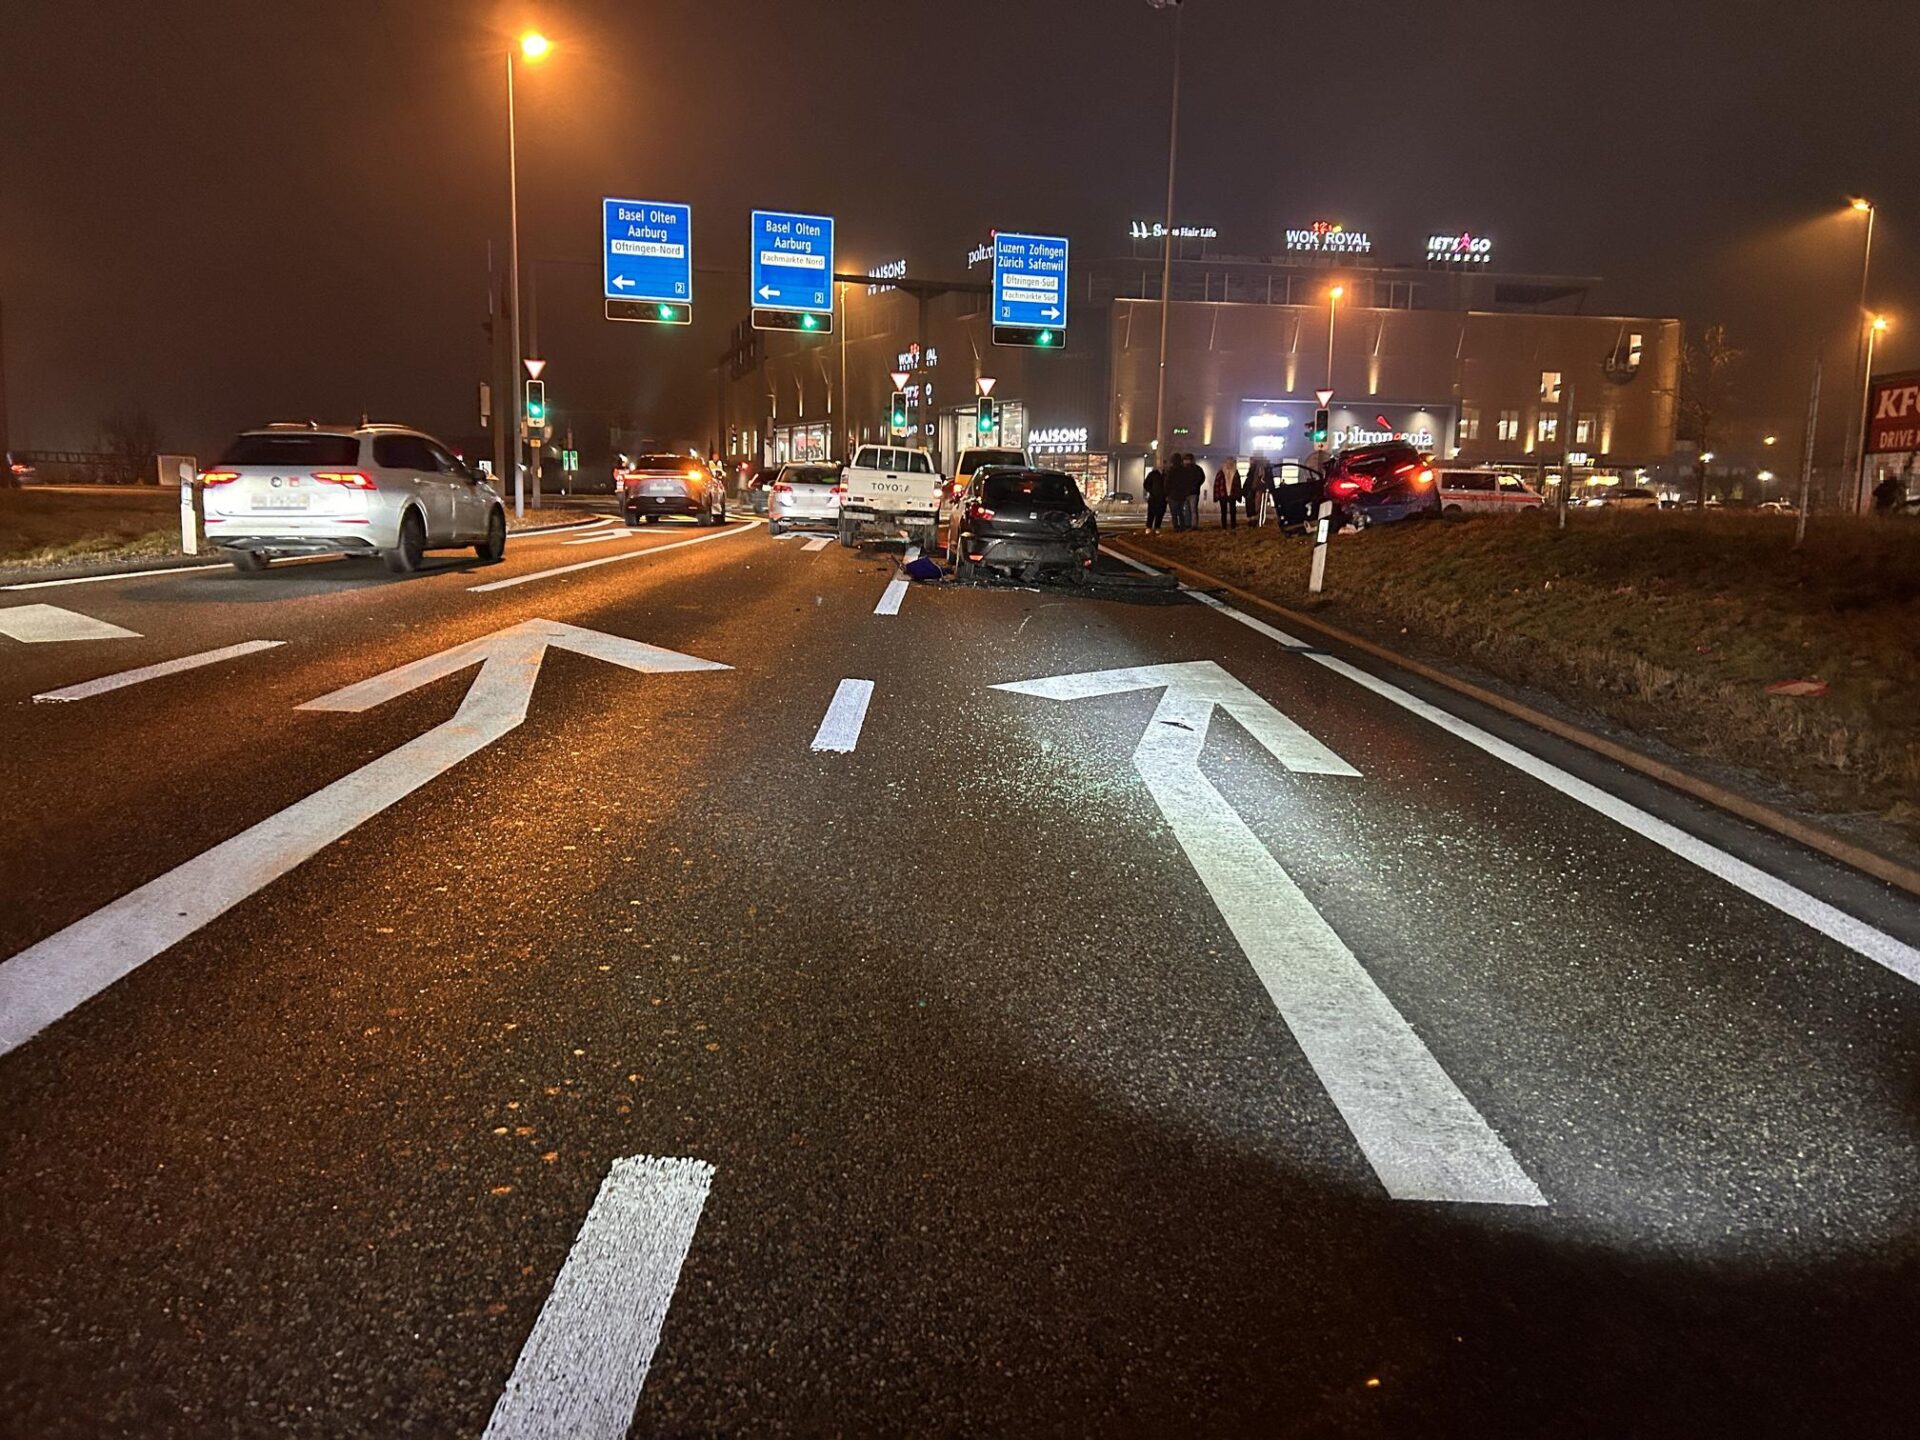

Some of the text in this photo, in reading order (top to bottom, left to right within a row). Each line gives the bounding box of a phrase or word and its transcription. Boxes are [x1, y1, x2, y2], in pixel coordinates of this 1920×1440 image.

[618, 208, 676, 224] Basel Olten
[628, 224, 668, 242] Aarburg
[766, 220, 820, 236] Basel Olten
[1152, 224, 1217, 238] Swss Hair Life
[774, 236, 812, 253] Aarburg
[1286, 230, 1371, 246] WOK ROYAL
[1428, 236, 1492, 252] LET'S GO
[615, 242, 681, 256] Oftringen-Nord
[998, 241, 1064, 260] Luzern Zofingen
[806, 257, 823, 266] Nord
[998, 256, 1064, 271] Zürich Safenwil
[1427, 252, 1490, 263] FITNESS
[1006, 276, 1056, 288] Oftringen-Süd
[1875, 386, 1920, 420] KF
[1028, 427, 1088, 443] MAISONS
[1879, 430, 1914, 449] DRIVE
[1048, 445, 1087, 454] MONDE
